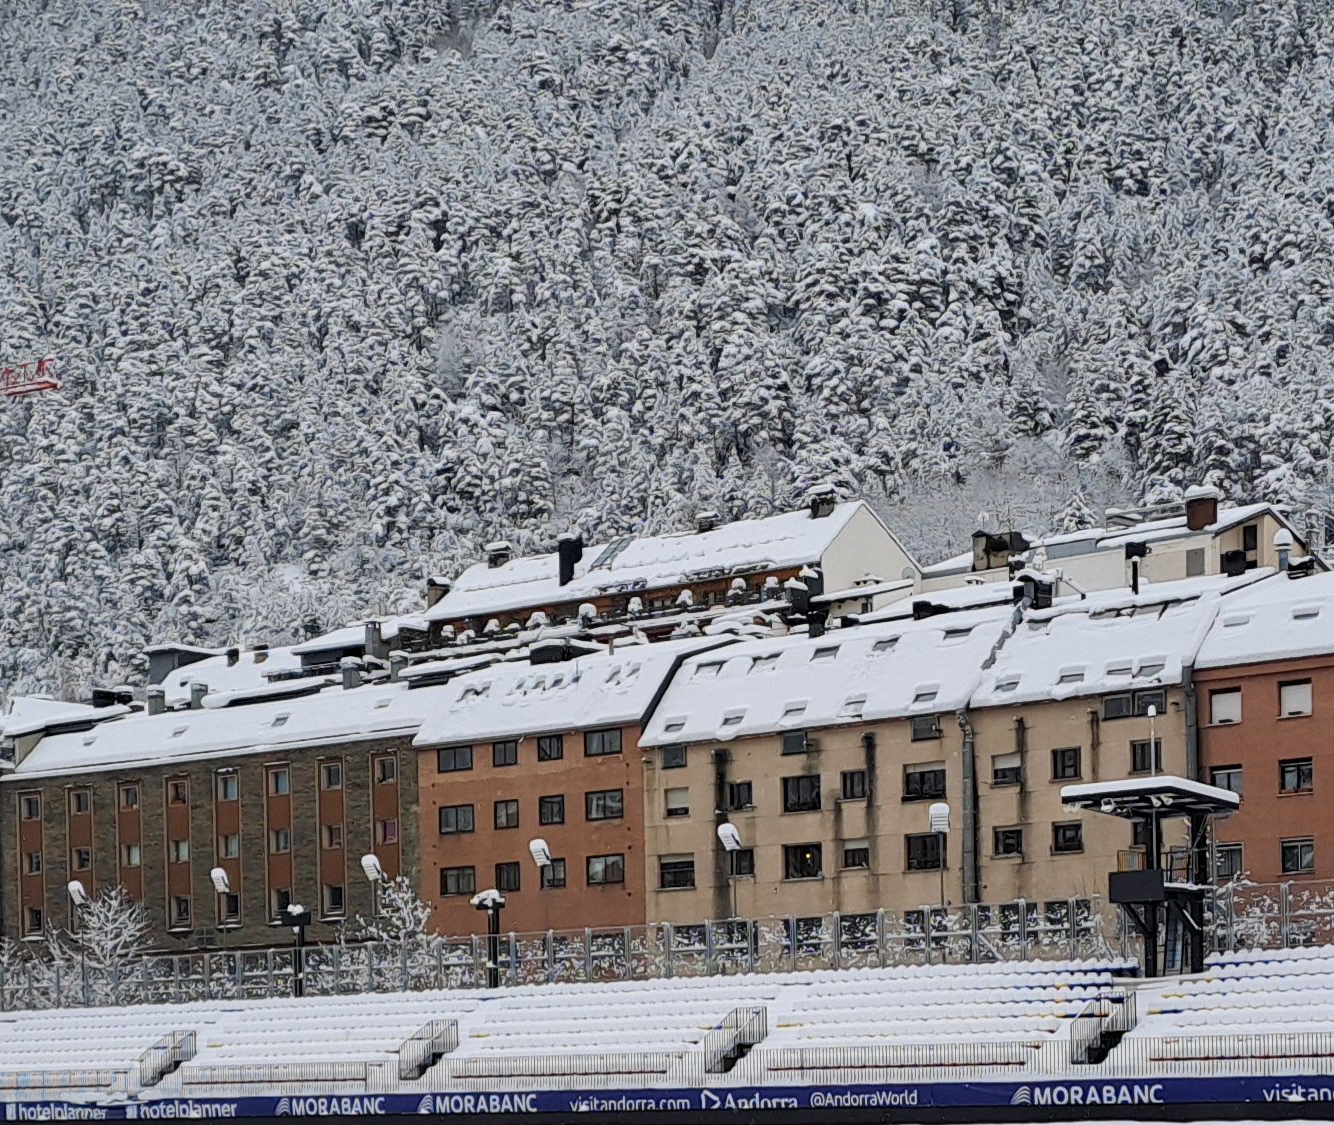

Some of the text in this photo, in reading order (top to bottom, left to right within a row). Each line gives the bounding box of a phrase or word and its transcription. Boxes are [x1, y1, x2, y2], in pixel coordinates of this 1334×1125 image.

[436, 1094, 538, 1114] MORABANC
[569, 1089, 918, 1111] visitandorra.com Andorra @AndorraWorld
[1034, 1084, 1164, 1106] MORABANC
[19, 1103, 107, 1120] hotelplanner
[140, 1100, 237, 1119] hotelplanner
[292, 1097, 385, 1116] MORABANC
